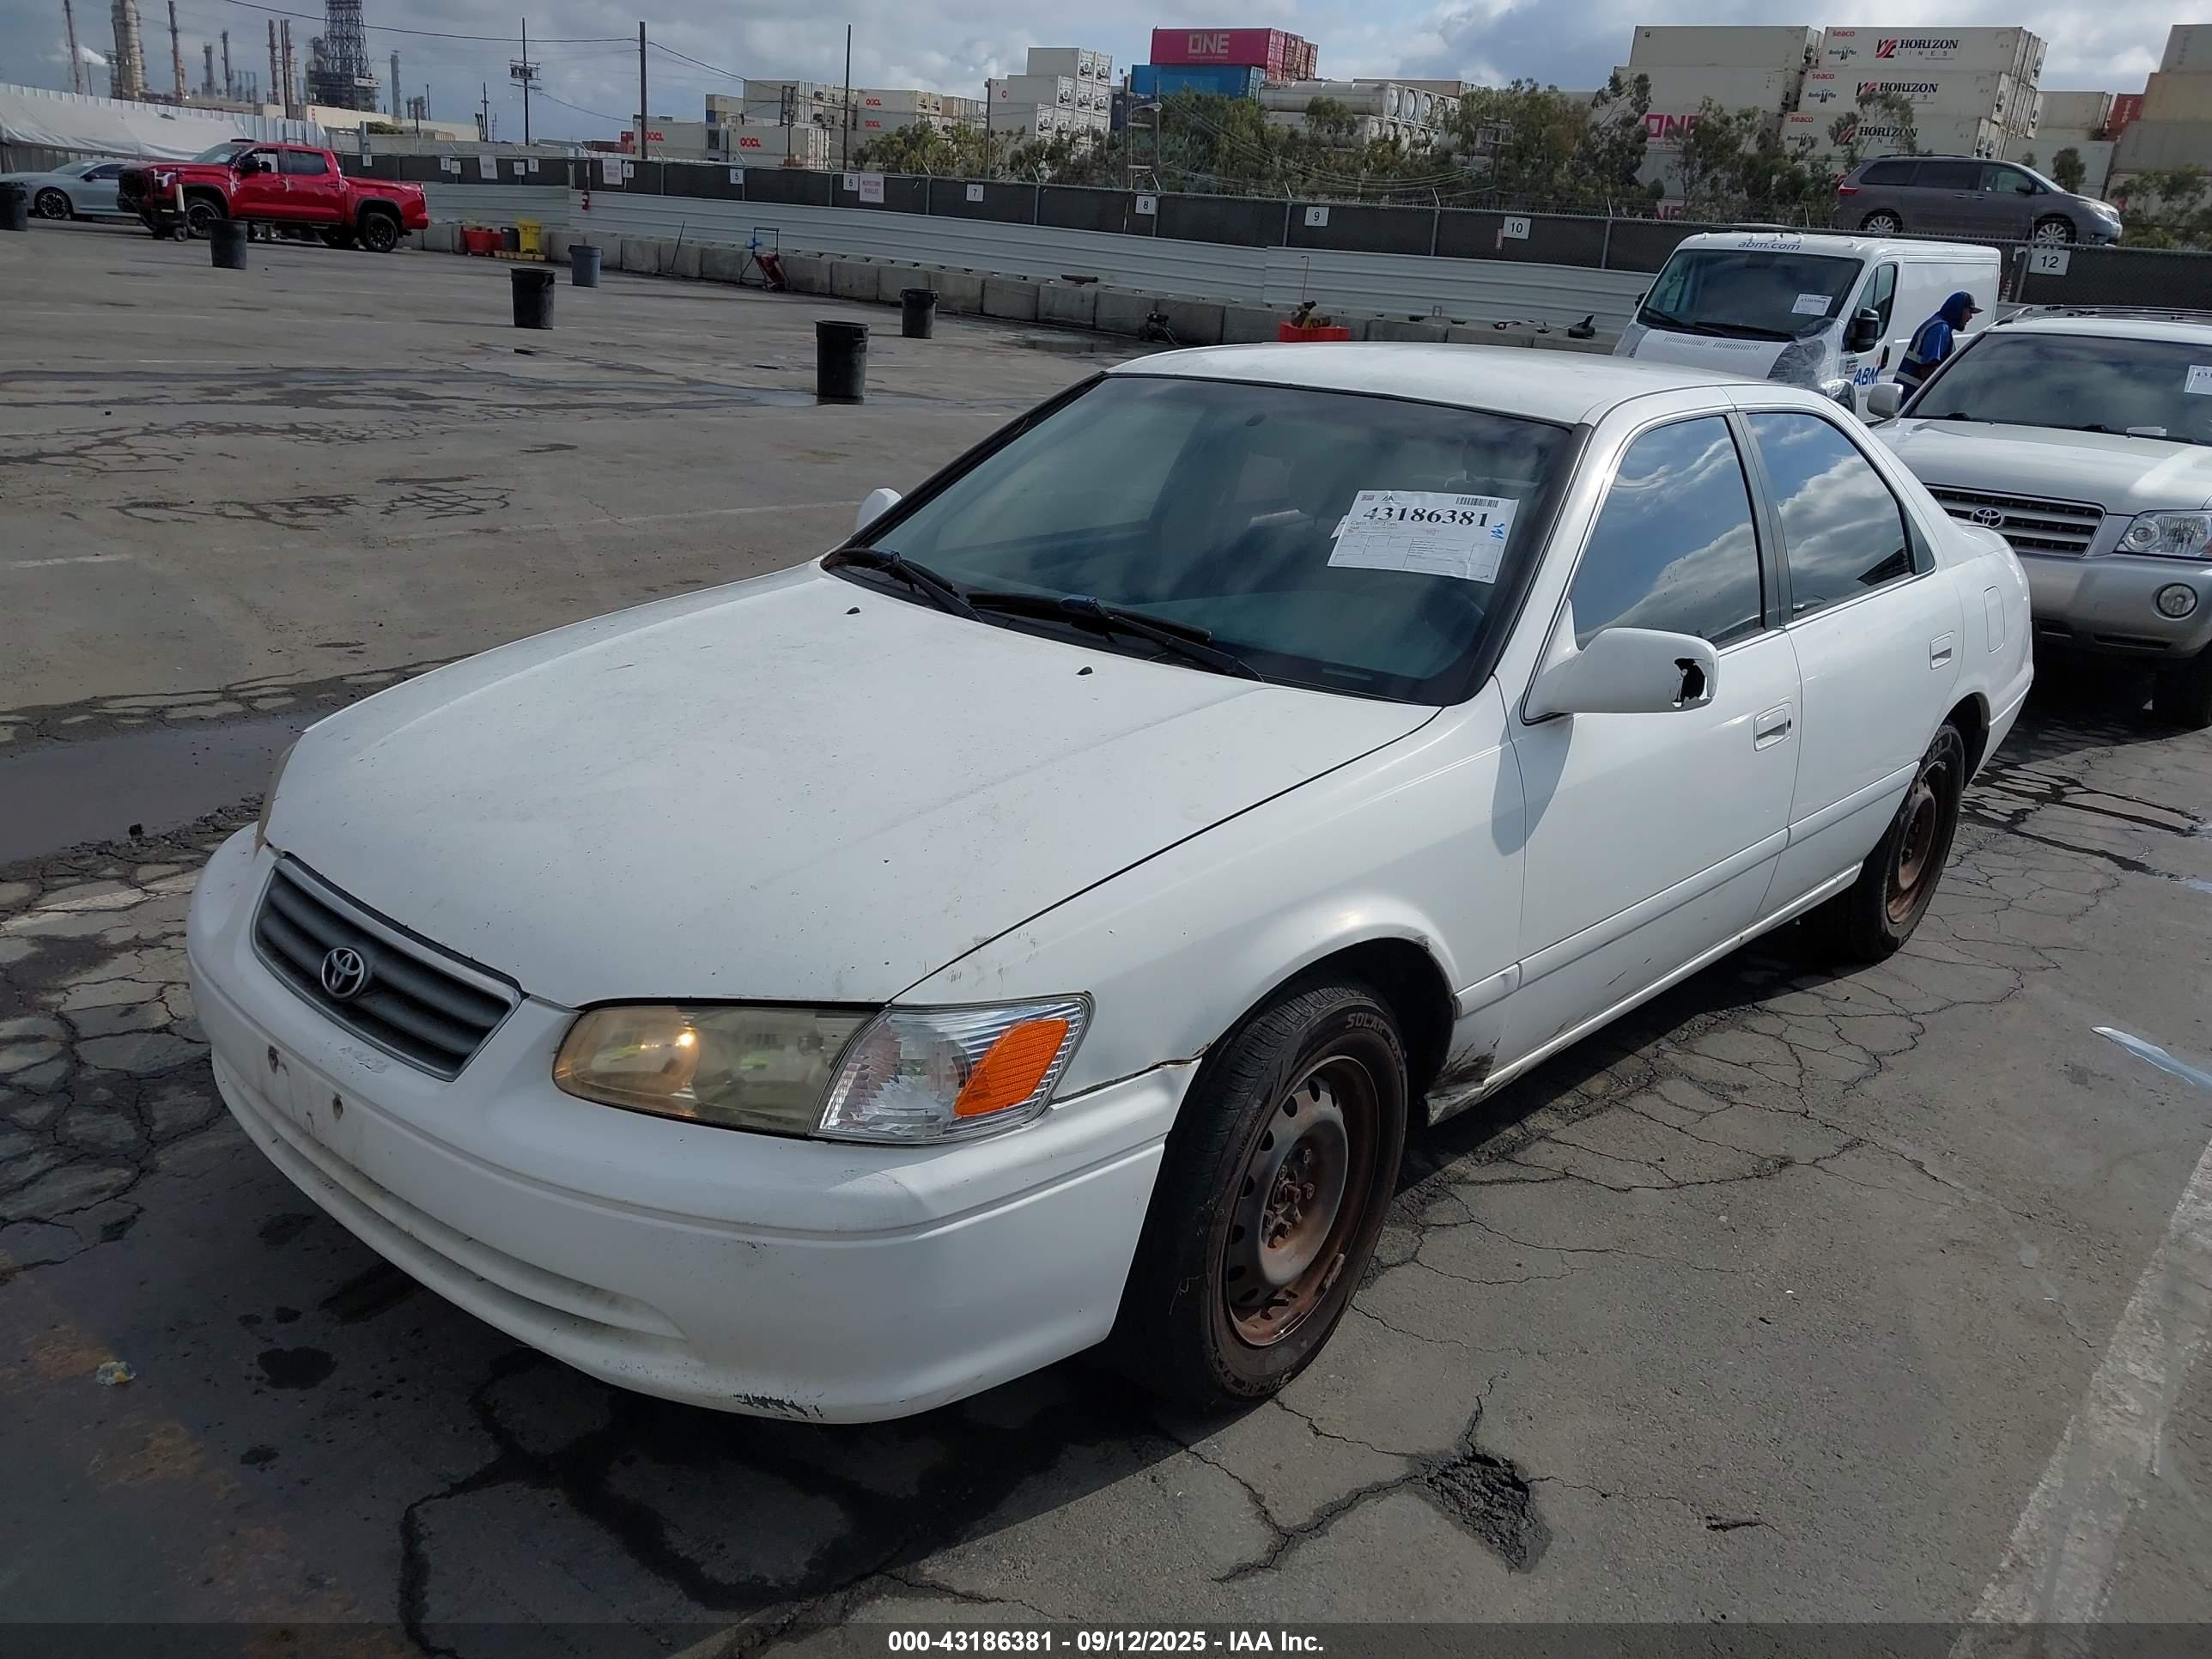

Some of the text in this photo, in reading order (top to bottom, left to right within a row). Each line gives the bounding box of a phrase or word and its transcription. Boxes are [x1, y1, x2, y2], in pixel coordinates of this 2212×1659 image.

[1188, 33, 1230, 53] ONE
[1899, 40, 1960, 49] HORIZON
[1880, 82, 1939, 93] HORIZON
[1859, 126, 1918, 137] HORIZON
[740, 137, 761, 148] OOCL
[1143, 200, 1149, 210] 8
[1314, 211, 1320, 221] 9
[1510, 222, 1523, 234] 10
[1738, 240, 1801, 251] abm.com
[2040, 255, 2059, 269] 12
[1853, 367, 1881, 386] ABM
[1363, 507, 1489, 527] 43186381
[1346, 1012, 1388, 1034] SOLAR
